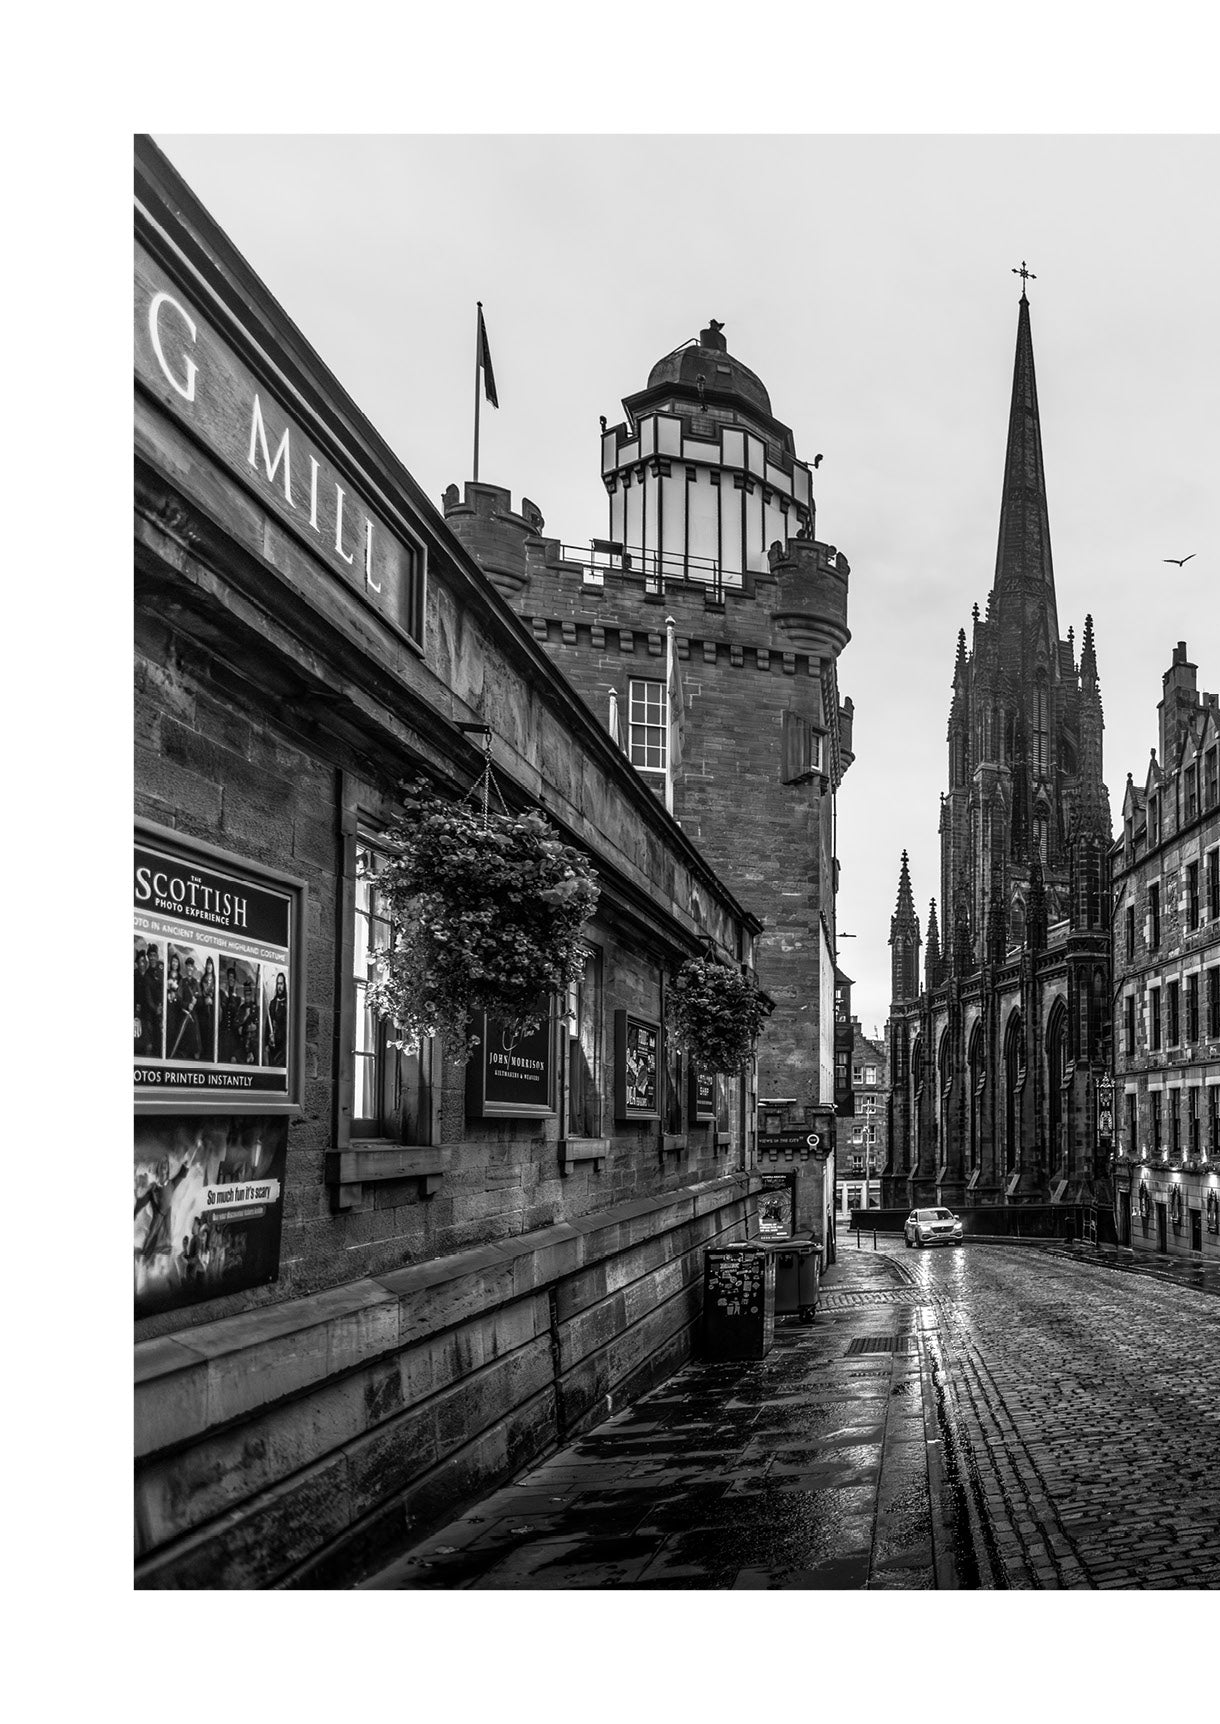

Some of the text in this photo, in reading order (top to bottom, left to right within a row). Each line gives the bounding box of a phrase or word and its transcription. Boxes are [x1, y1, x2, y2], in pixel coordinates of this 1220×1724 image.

[149, 290, 382, 594] G MILL
[190, 875, 202, 883] THE
[135, 867, 248, 928] SCOTTISH
[155, 897, 230, 926] PHOTO EXPERIENCE
[151, 921, 160, 931] IN
[162, 923, 194, 939] ANCIENT
[195, 932, 227, 947] SCOTTISH
[228, 941, 259, 955] HIGHLAND
[260, 949, 286, 962] COSTUME
[489, 1052, 544, 1070] JOHN MORRISON
[165, 1072, 206, 1084] PRINTED
[208, 1074, 254, 1087] INSTANTLY
[206, 1185, 271, 1206] So much fun it's scary
